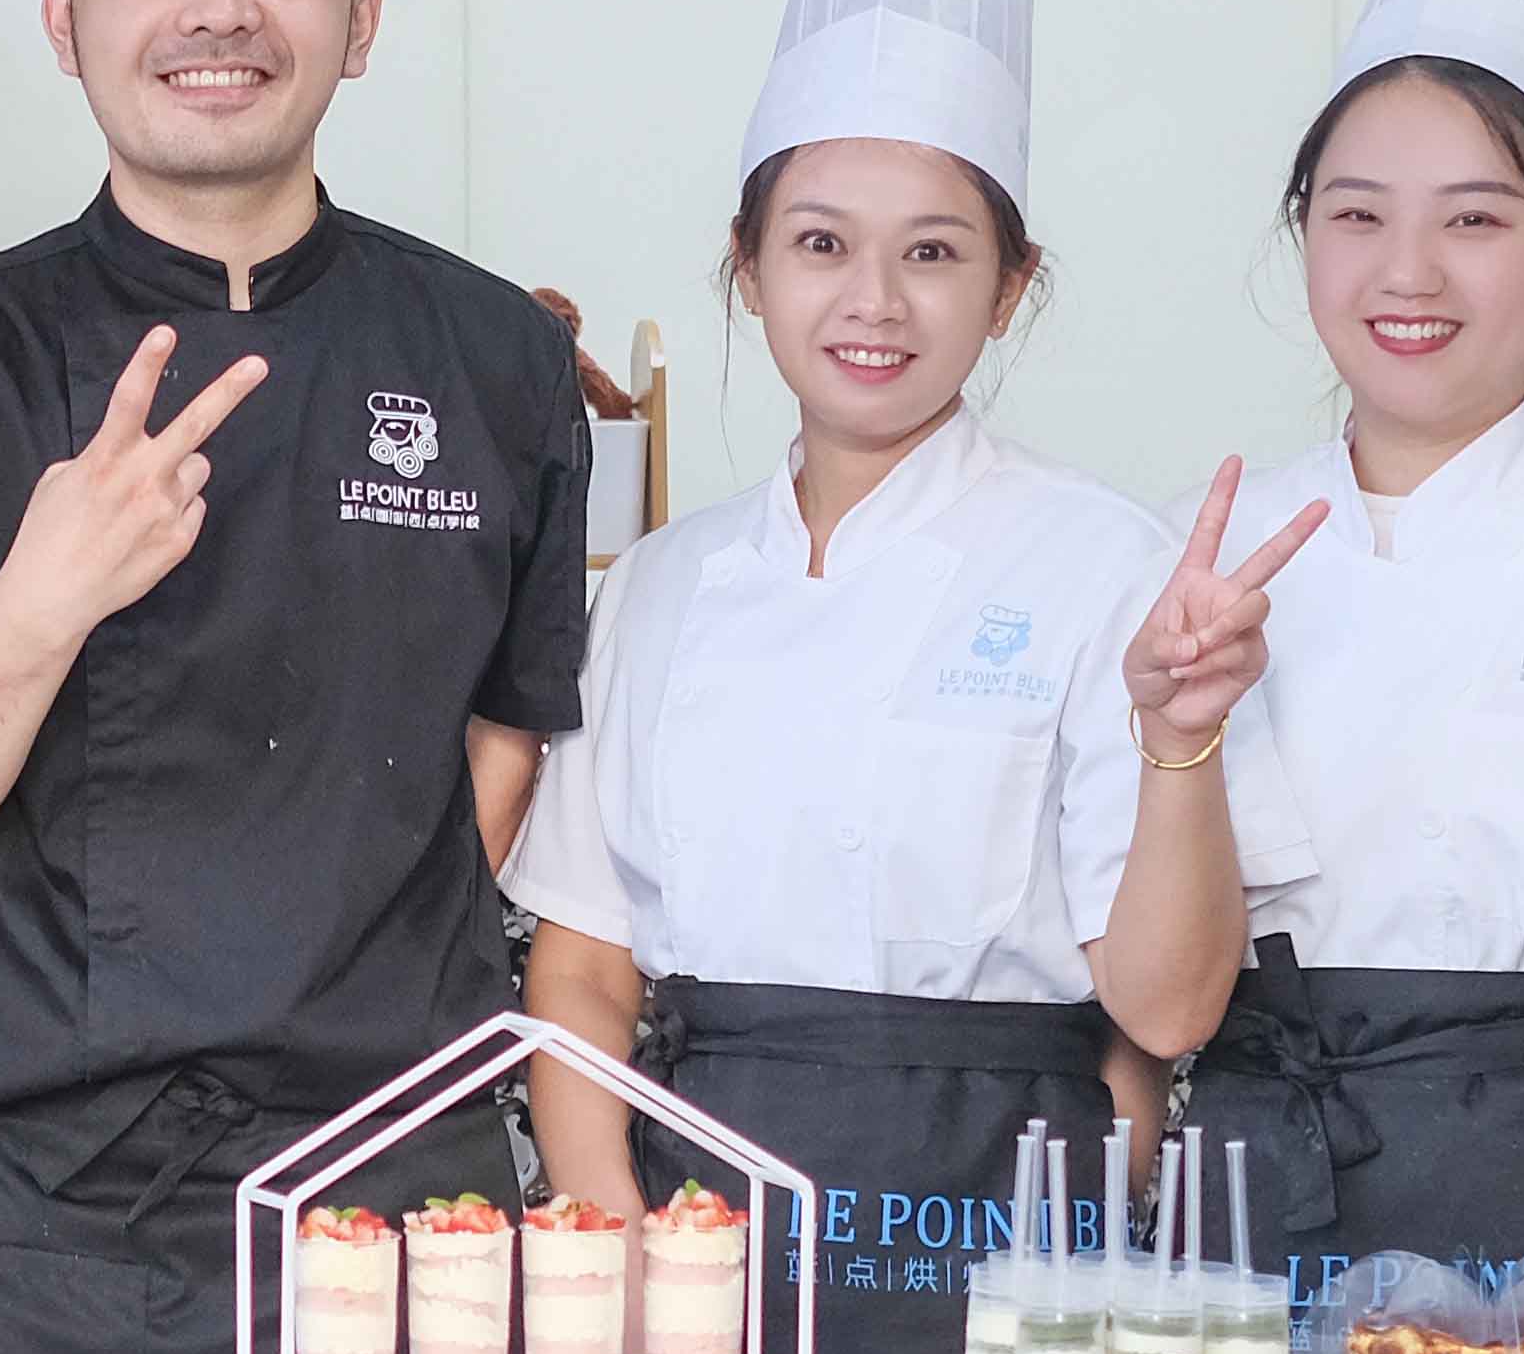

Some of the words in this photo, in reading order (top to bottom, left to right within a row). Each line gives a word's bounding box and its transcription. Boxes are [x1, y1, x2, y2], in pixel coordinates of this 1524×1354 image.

[340, 479, 364, 502] LE
[366, 482, 424, 510] POINT
[426, 489, 478, 513] BLEU
[936, 668, 962, 686] LE
[963, 669, 1014, 688] POINT
[1015, 671, 1057, 696] BLEU
[1288, 1255, 1350, 1308] LE
